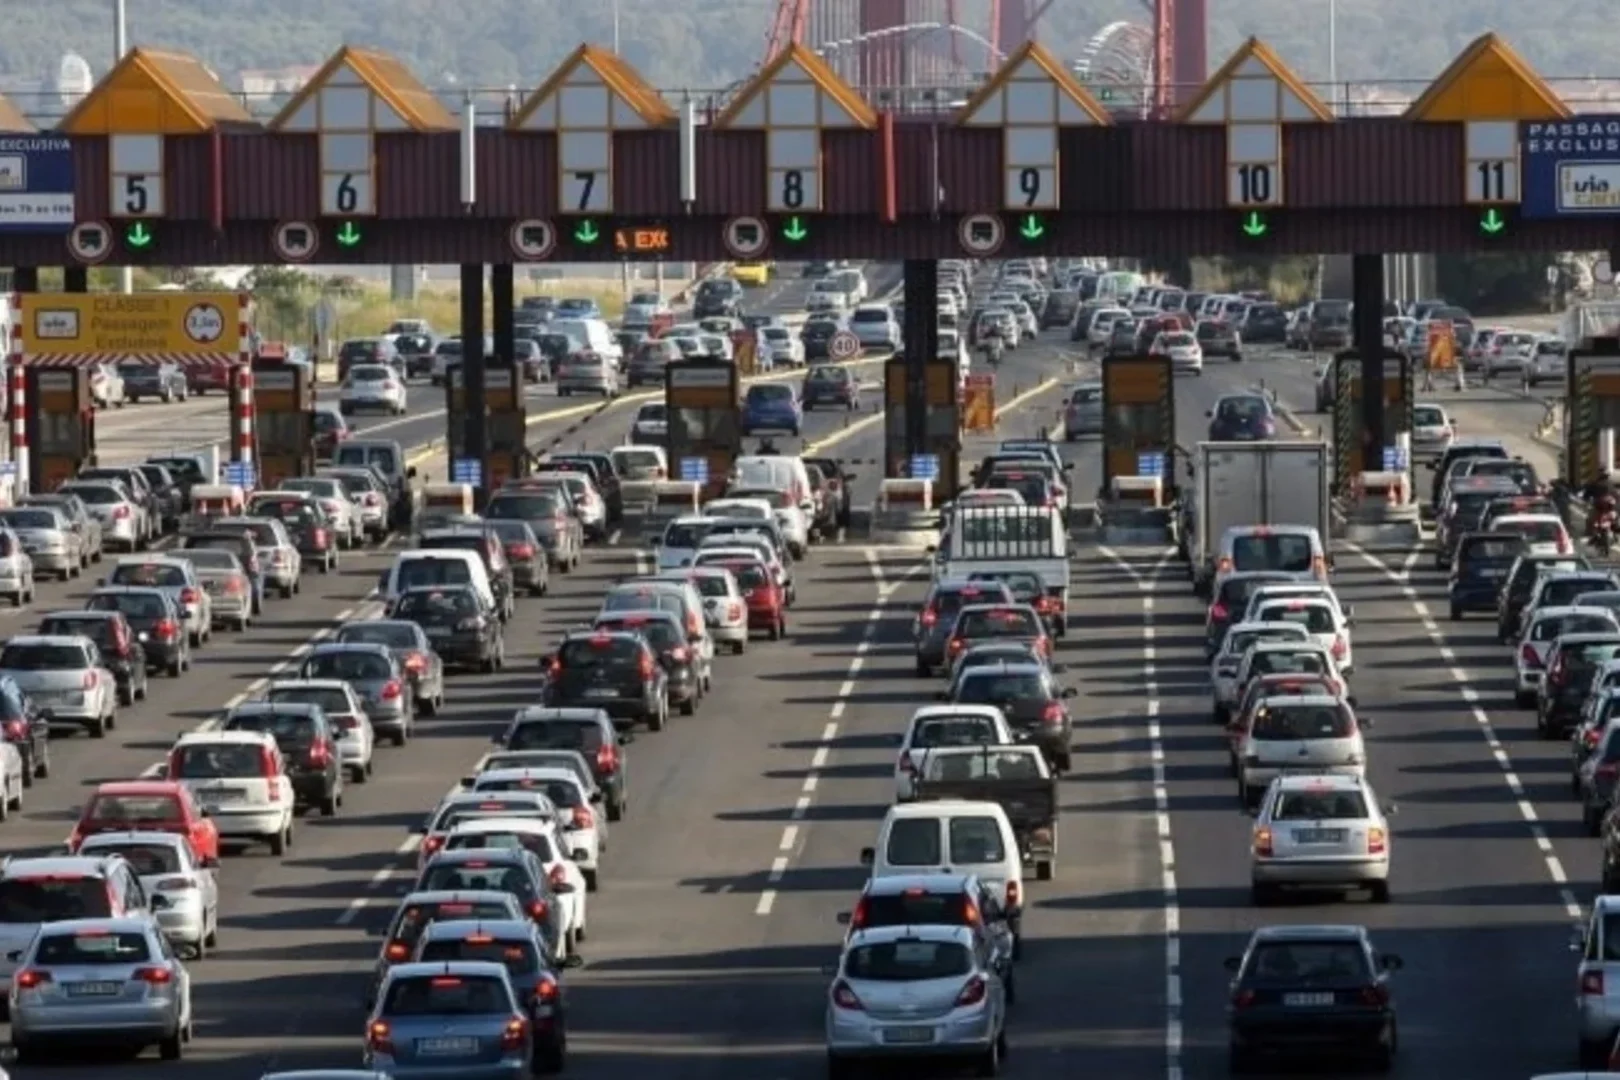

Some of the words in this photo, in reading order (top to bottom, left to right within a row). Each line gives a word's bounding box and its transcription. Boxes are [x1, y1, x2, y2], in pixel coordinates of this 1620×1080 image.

[126, 174, 147, 214] 5
[337, 173, 357, 212] 6
[575, 171, 595, 211] 7
[783, 170, 804, 208] 8
[1020, 167, 1040, 206] 9
[1238, 164, 1271, 203] 10
[1478, 161, 1505, 200] 11
